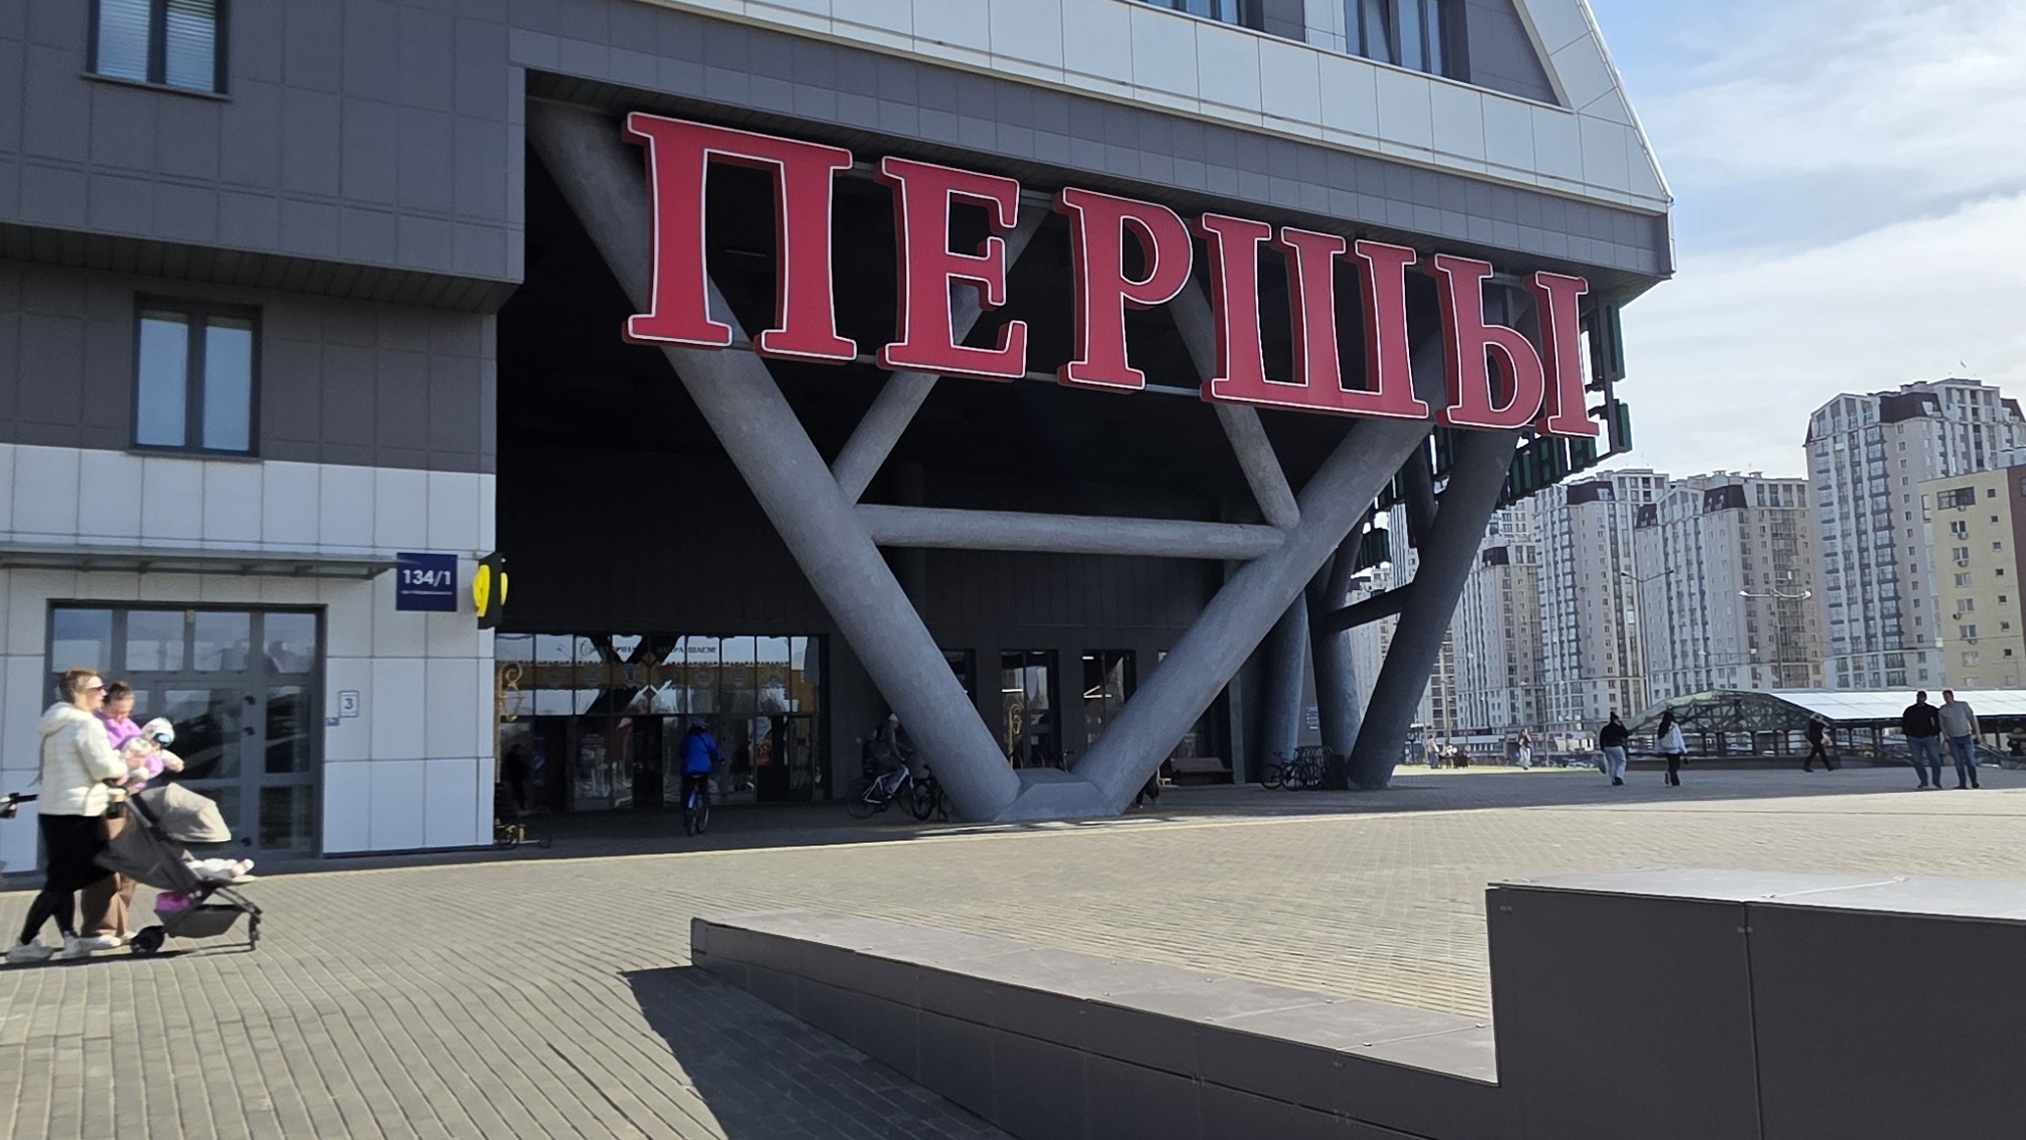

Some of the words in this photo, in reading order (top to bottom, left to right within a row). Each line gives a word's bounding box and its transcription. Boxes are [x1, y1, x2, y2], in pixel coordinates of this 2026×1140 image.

[623, 111, 1600, 437] ПЕРШЫ
[403, 569, 452, 587] 134/1
[344, 697, 354, 710] 3
